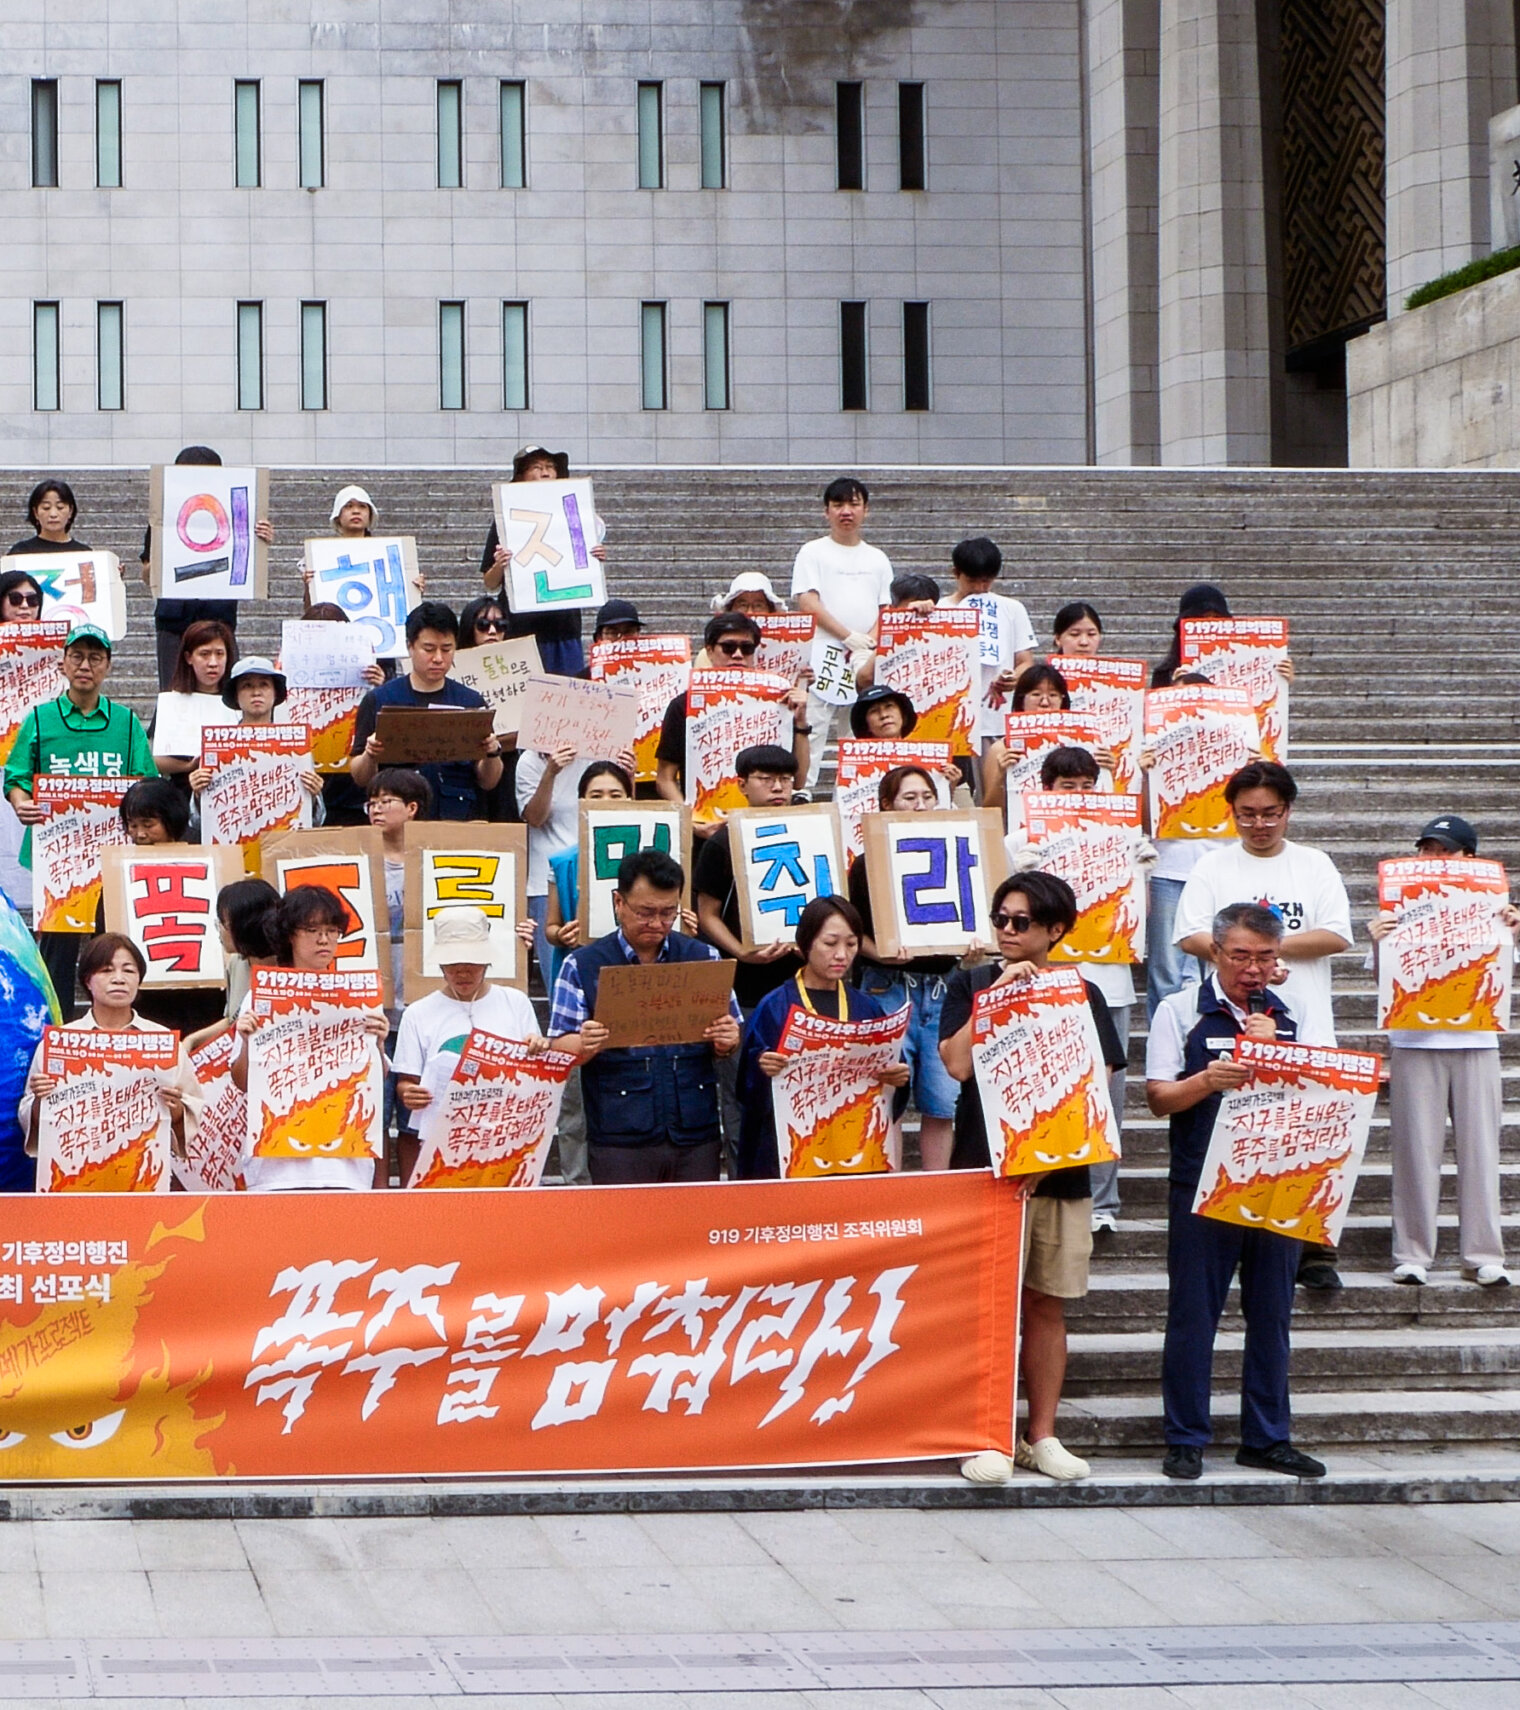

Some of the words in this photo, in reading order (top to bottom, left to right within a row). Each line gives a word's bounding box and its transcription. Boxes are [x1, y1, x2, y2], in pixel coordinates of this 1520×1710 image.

[173, 486, 249, 586] 의
[510, 493, 593, 604] 진
[320, 545, 407, 653] 행
[816, 644, 843, 691] 먹거리
[49, 751, 124, 777] 녹색당
[129, 862, 210, 973] 폭
[752, 825, 835, 927] 춰
[896, 837, 979, 933] 라
[2, 1241, 128, 1265] 기후정의행진
[709, 1228, 739, 1245] 919
[744, 1223, 838, 1245] 기후정의행진
[843, 1217, 923, 1240] 조직위원회
[30, 1273, 111, 1304] 선포식
